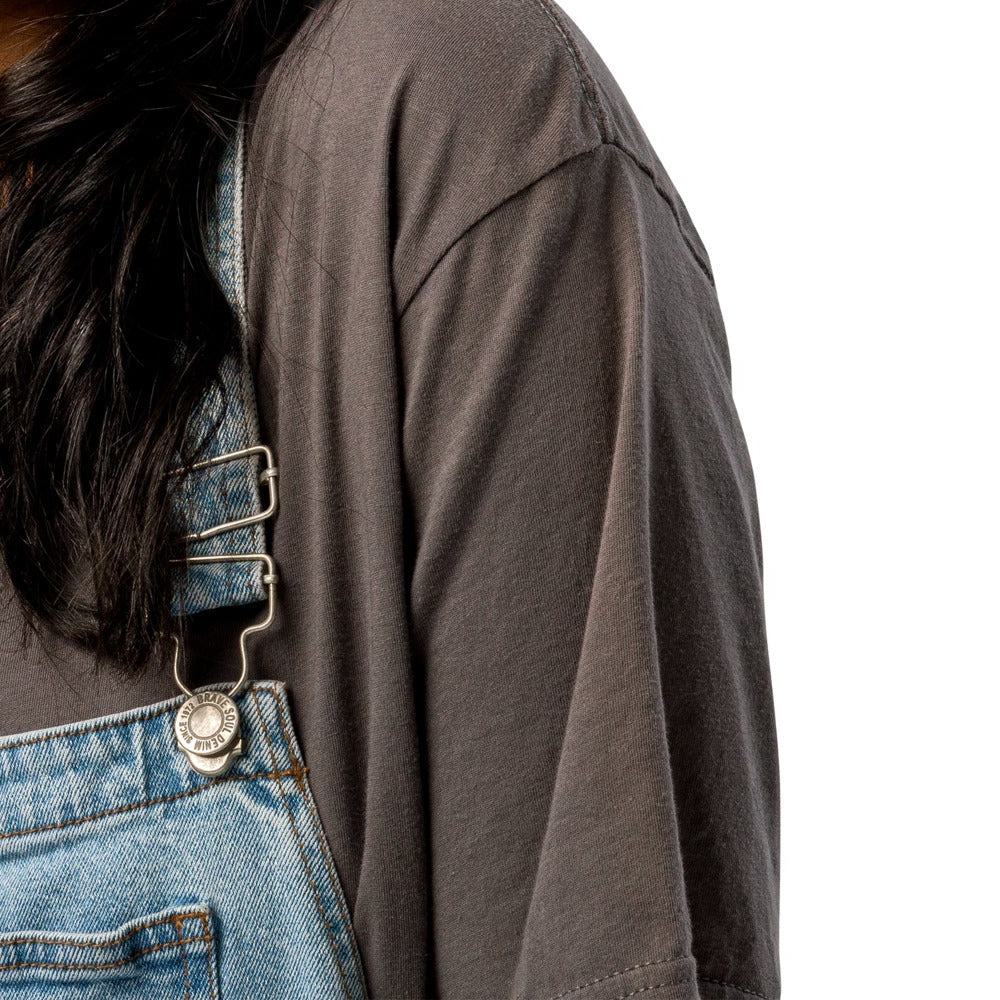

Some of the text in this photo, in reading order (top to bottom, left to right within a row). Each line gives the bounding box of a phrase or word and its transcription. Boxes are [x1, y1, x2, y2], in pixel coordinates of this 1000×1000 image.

[196, 692, 230, 708] BRAVE
[222, 707, 236, 733] SOUL
[178, 722, 193, 744] SINCE
[193, 735, 226, 751] DENIM
